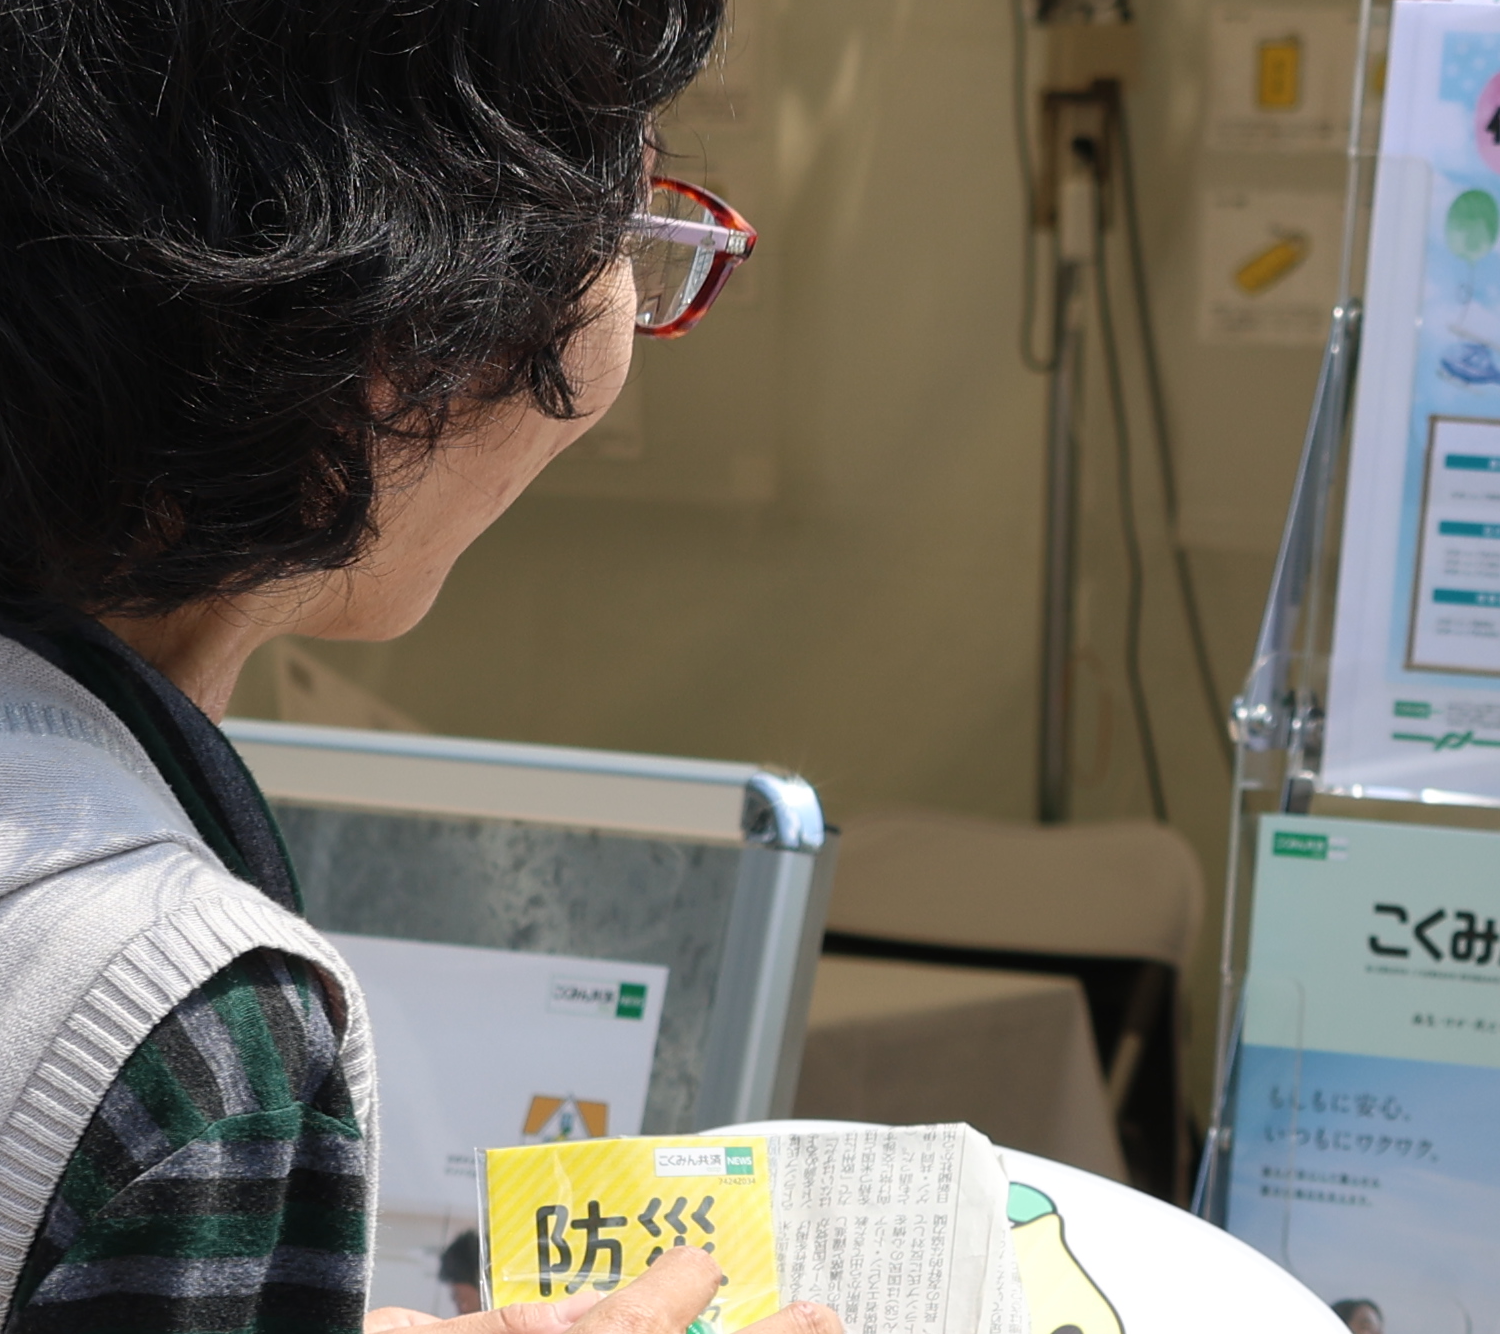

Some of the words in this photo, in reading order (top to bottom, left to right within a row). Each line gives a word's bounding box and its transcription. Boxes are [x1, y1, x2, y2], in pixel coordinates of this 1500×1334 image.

[658, 1153, 722, 1167] こくみん共済
[726, 1156, 753, 1166] NEWS
